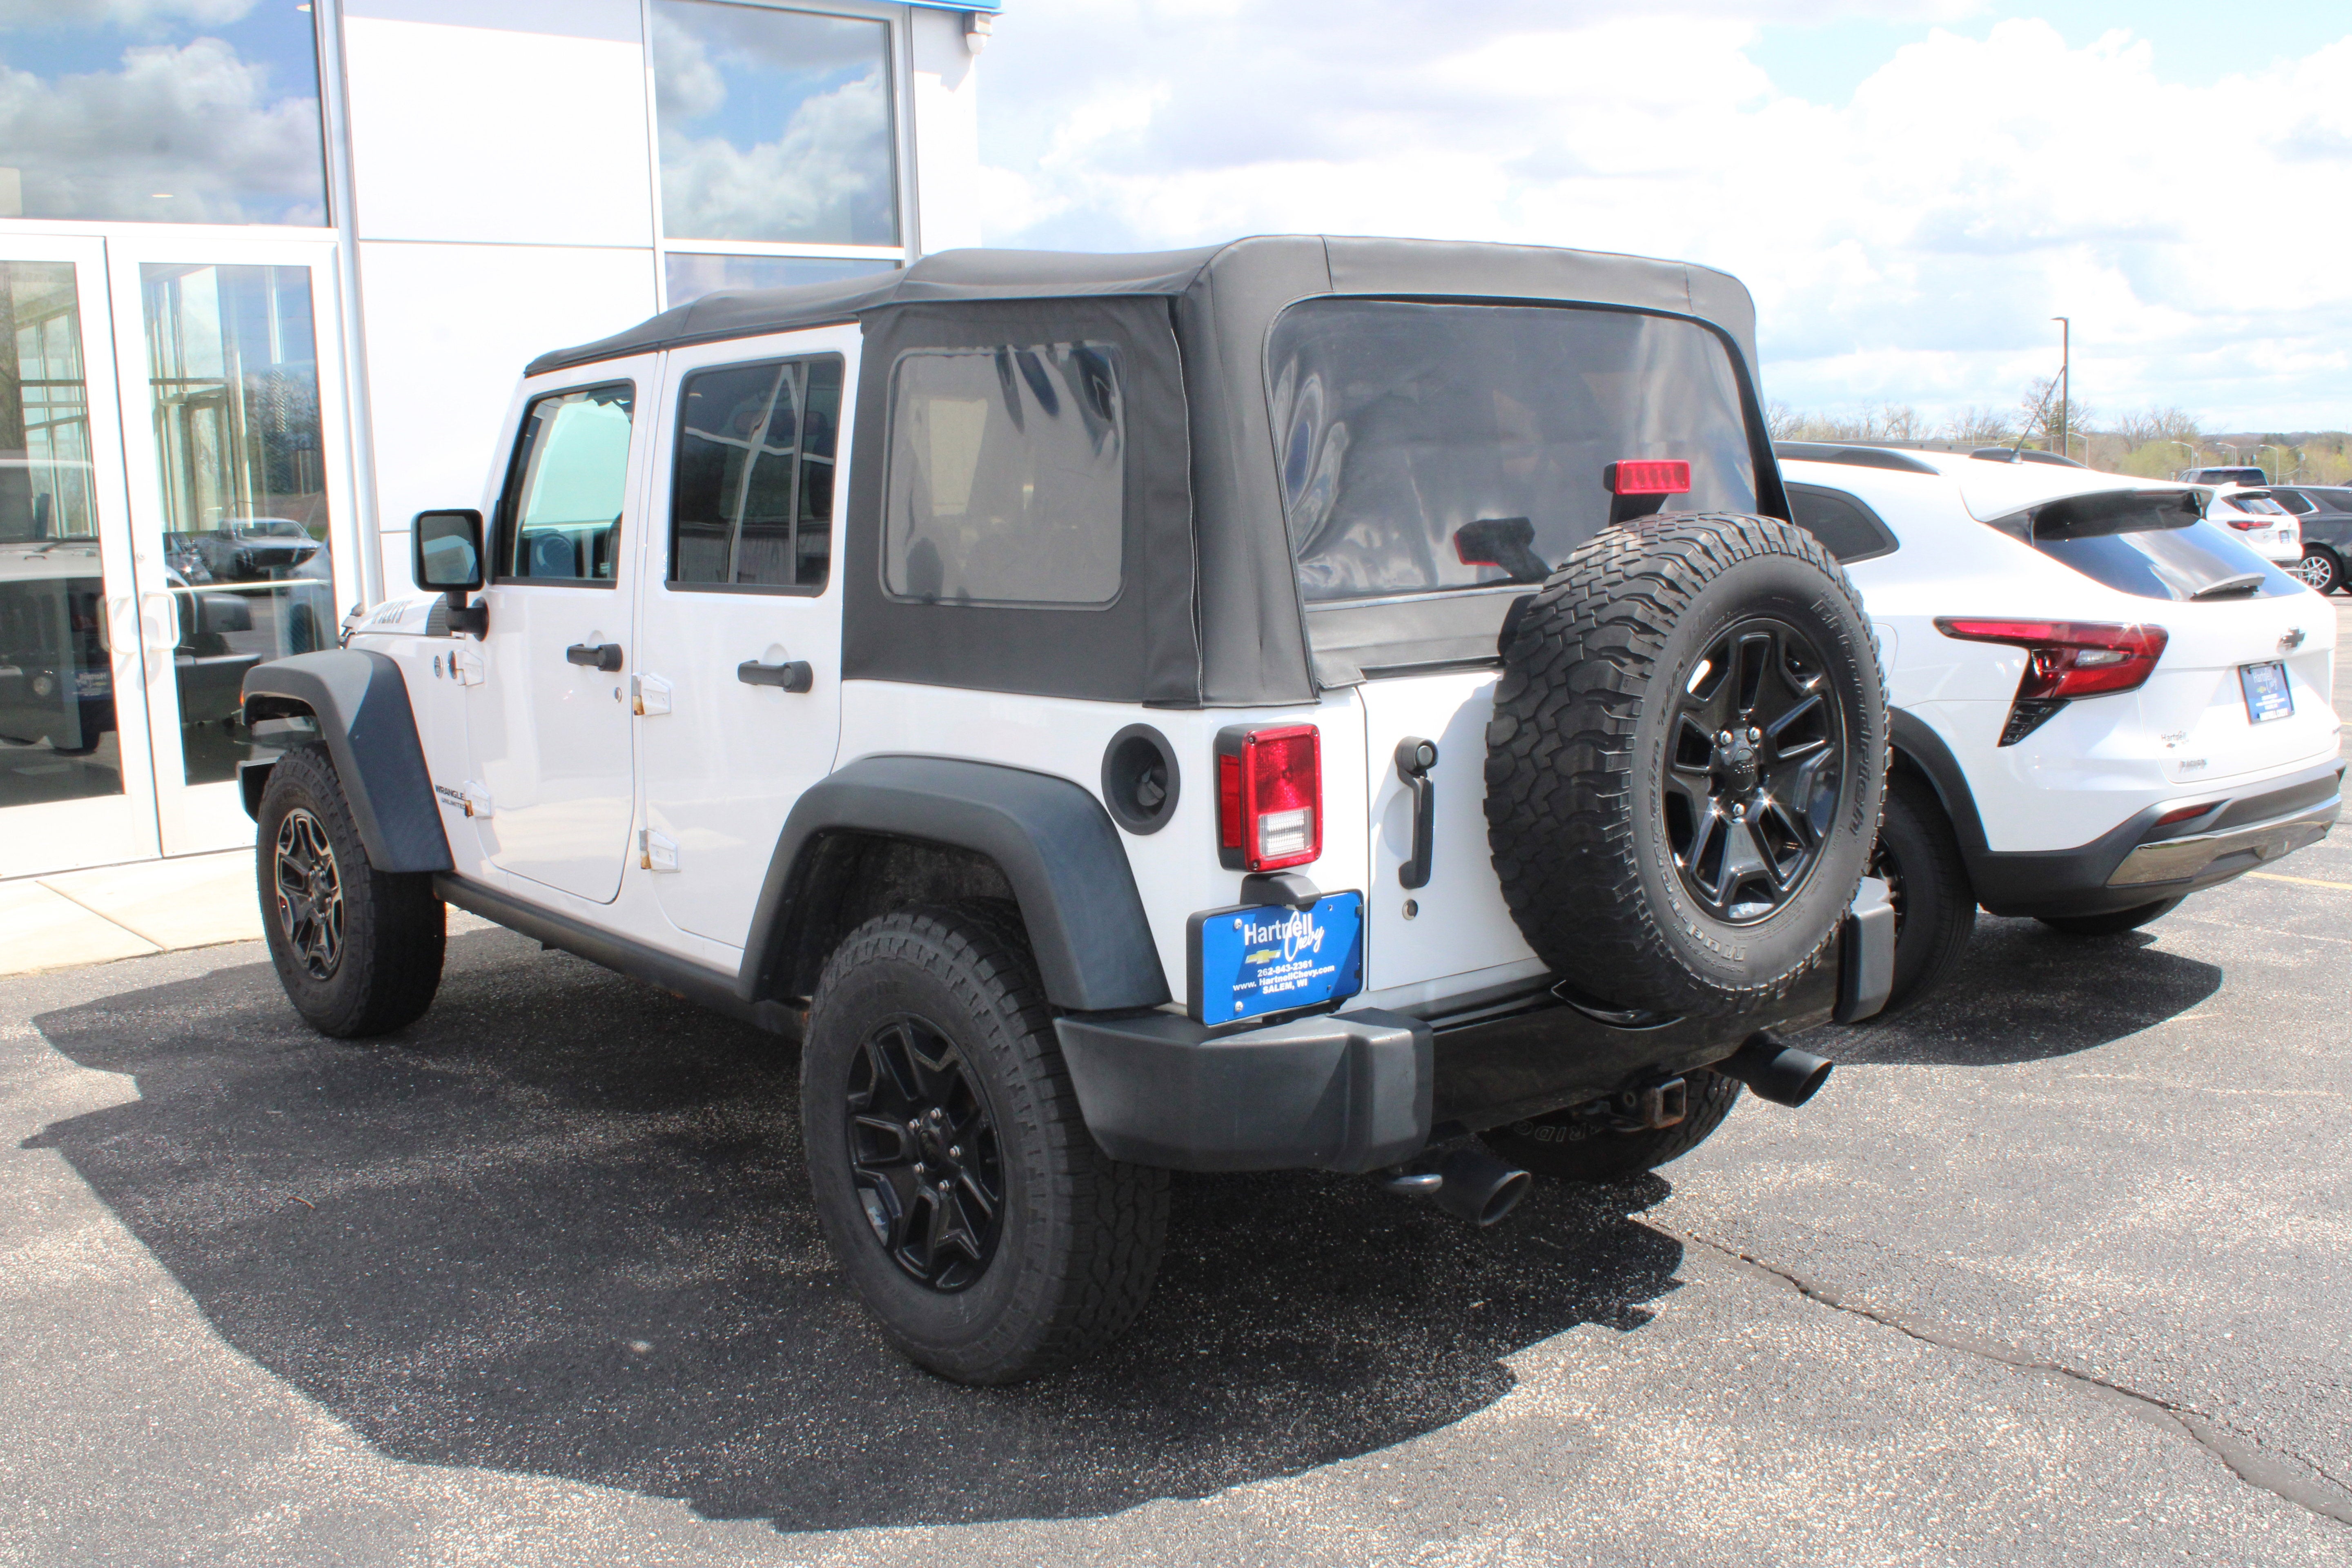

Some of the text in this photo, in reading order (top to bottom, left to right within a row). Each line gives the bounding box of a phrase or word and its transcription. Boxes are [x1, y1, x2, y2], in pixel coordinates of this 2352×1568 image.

[435, 784, 465, 799] WRANGLE
[1244, 913, 1313, 946] Hartnell
[1284, 911, 1324, 962] Chevy
[1257, 960, 1312, 977] 262-843-2361
[1263, 978, 1307, 994] SALEM, WI
